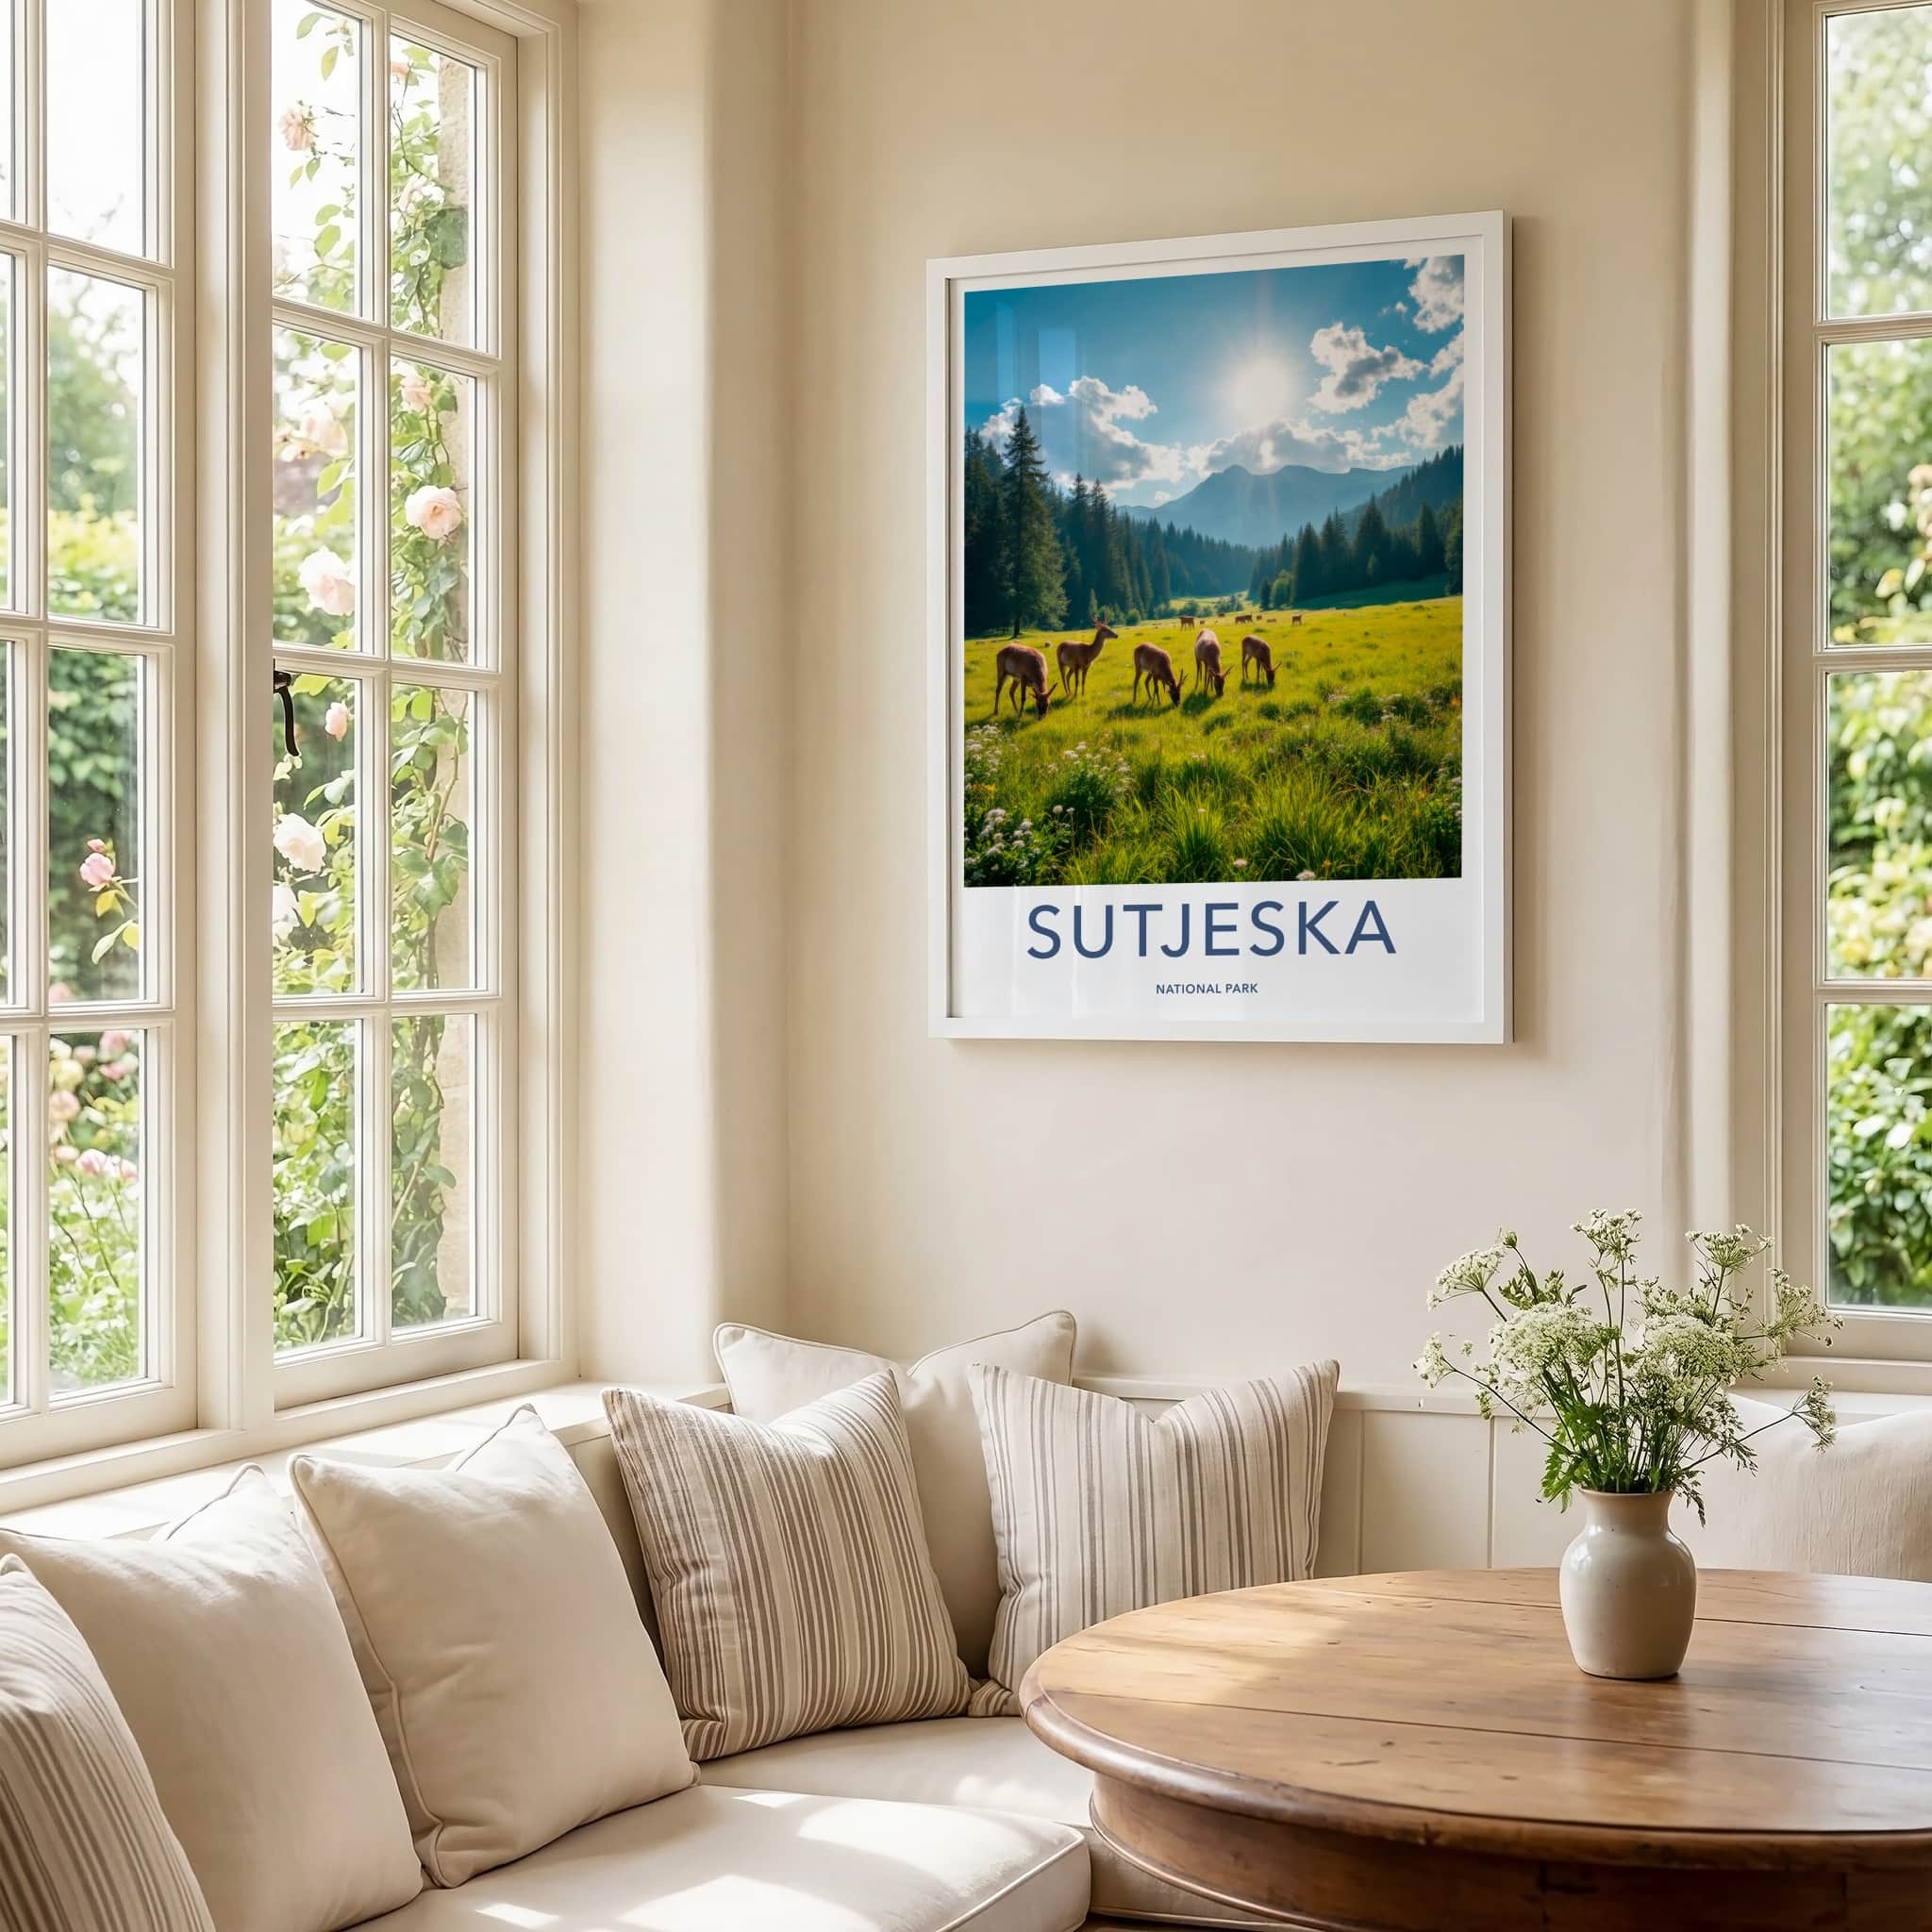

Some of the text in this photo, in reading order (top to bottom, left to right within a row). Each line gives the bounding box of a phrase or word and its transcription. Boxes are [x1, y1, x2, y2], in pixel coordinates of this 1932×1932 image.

[1026, 900, 1397, 959] SUTJESKA
[1156, 983, 1258, 994] NATIONAL PARK
